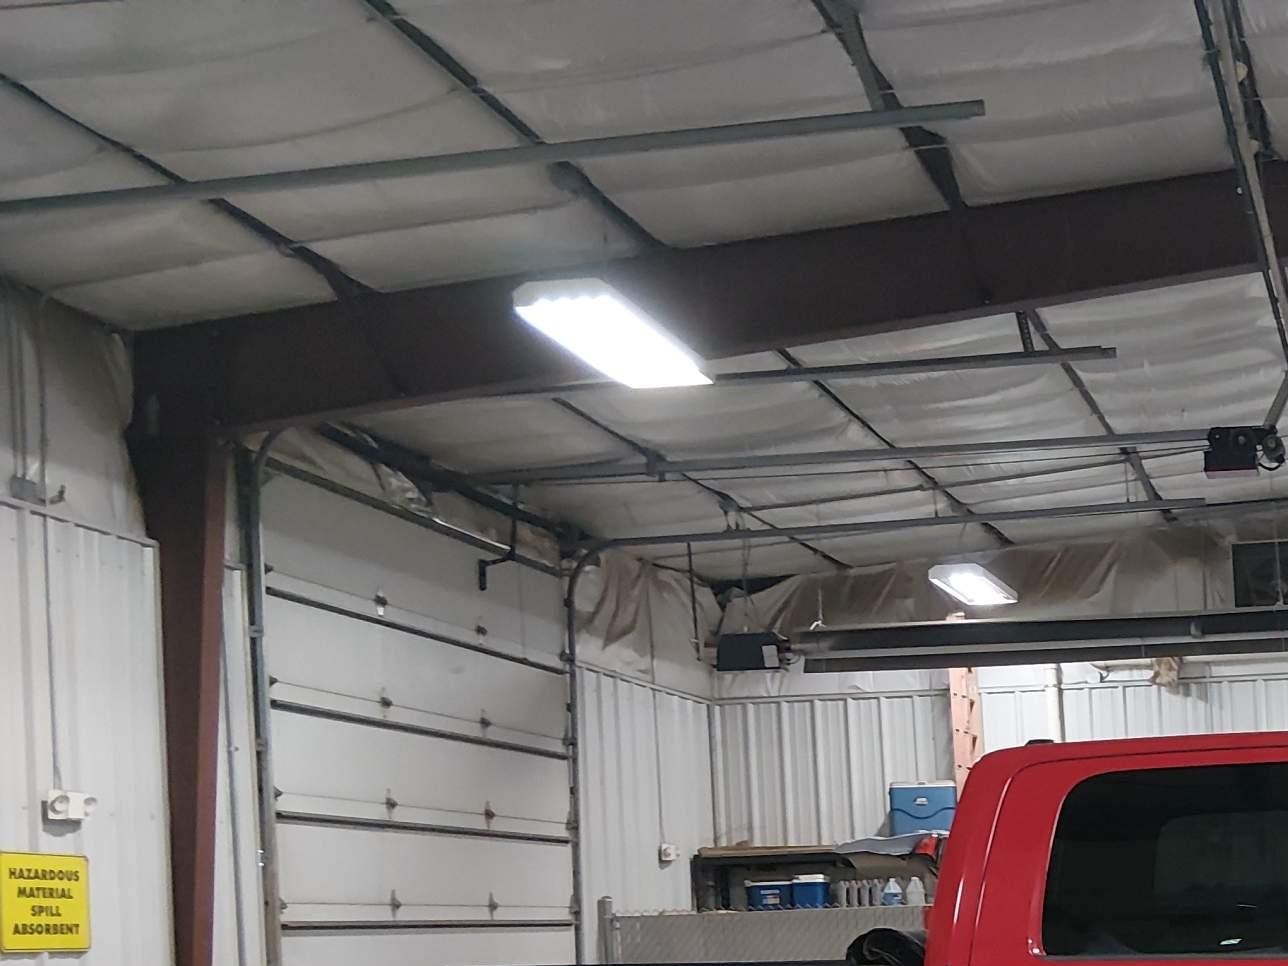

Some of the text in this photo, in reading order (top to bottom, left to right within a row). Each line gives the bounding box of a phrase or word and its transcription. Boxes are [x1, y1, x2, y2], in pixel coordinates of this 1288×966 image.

[8, 867, 80, 882] HAZARDOUS
[17, 886, 73, 899] MATERIAL
[31, 905, 61, 917] SPILL
[13, 923, 80, 935] ABSORBENT
